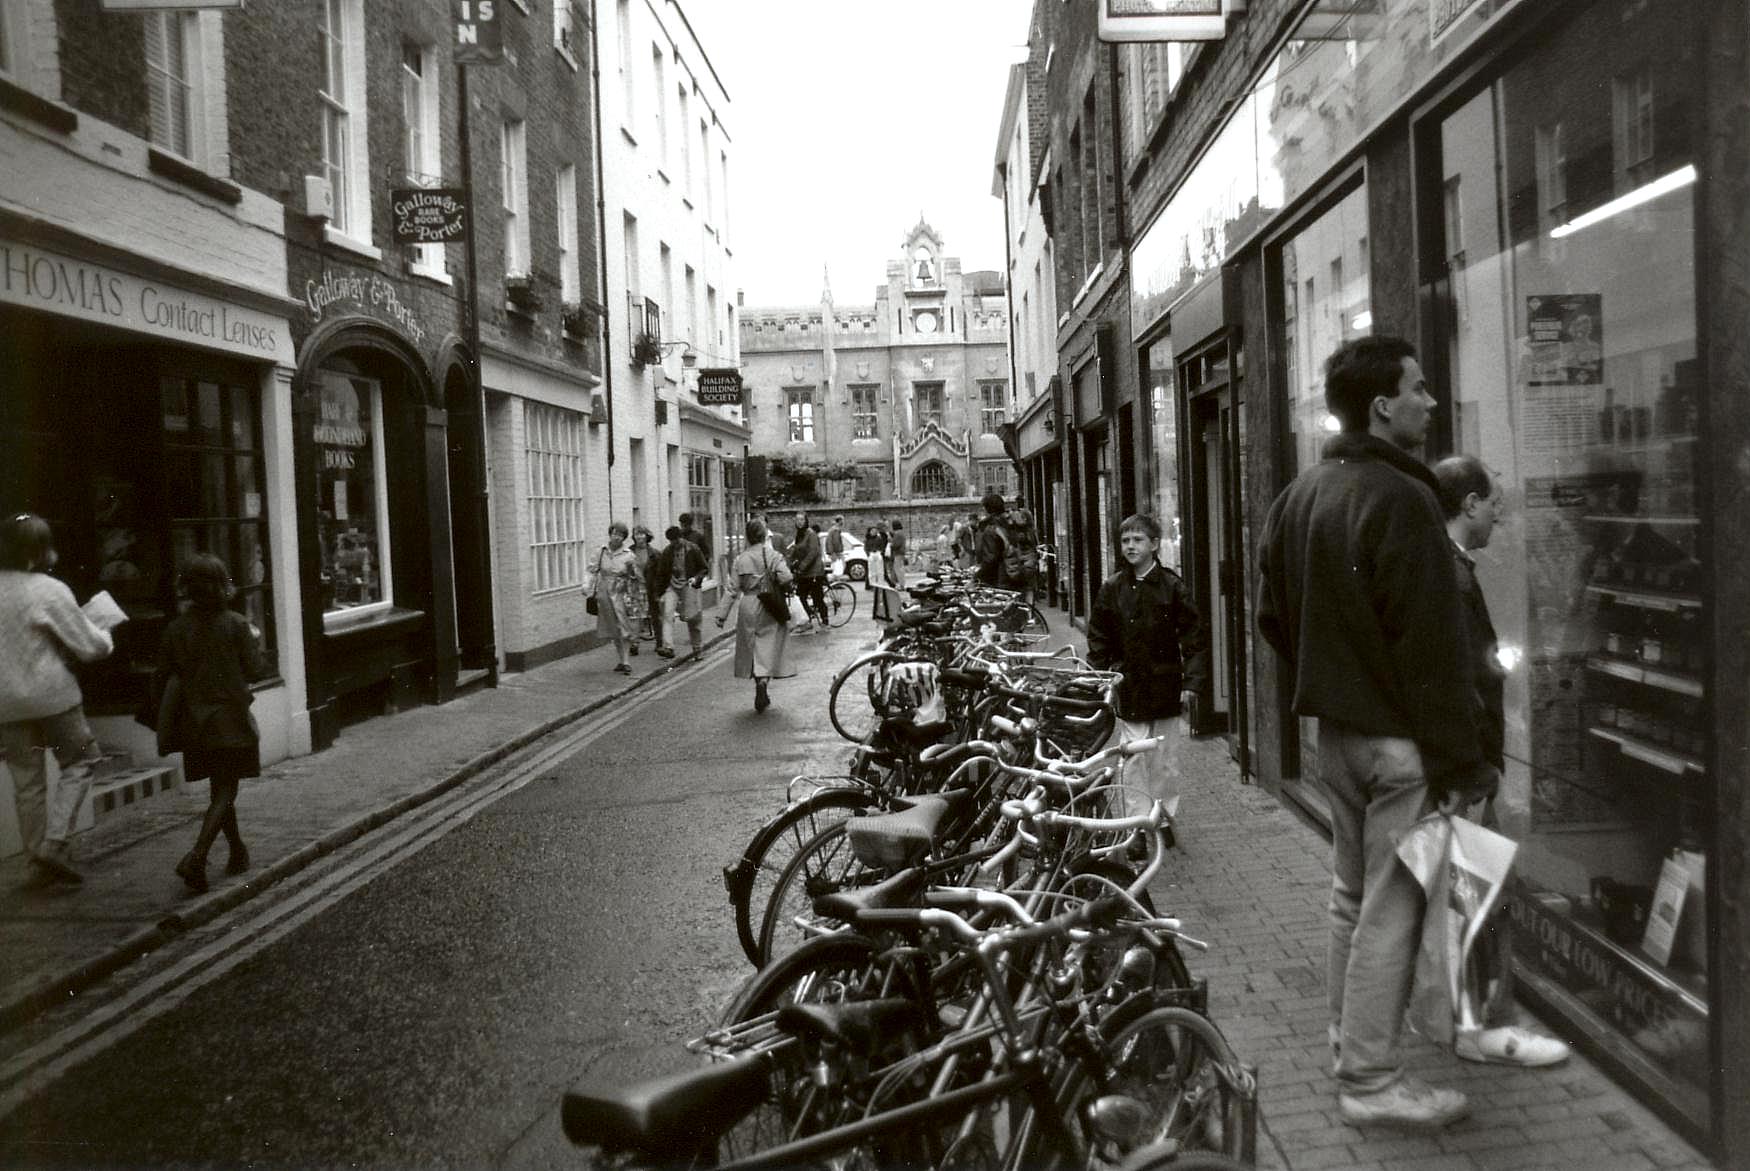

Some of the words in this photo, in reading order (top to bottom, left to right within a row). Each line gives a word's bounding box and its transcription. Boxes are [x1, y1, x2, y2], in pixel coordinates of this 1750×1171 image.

[394, 193, 464, 220] Galloway
[398, 221, 413, 234] &
[415, 215, 462, 240] Porter
[414, 216, 444, 224] BOOKS
[0, 247, 123, 316] HOMAS
[141, 286, 216, 338] Contact
[223, 307, 276, 351] Lenses
[306, 270, 363, 322] Galloway
[371, 276, 383, 305] &
[383, 282, 424, 342] Porter
[703, 376, 737, 384] HALIFAX
[703, 393, 738, 401] SOCIETY
[325, 450, 355, 468] BOOKS
[1540, 917, 1571, 961] OUR
[1574, 941, 1609, 987] LOW
